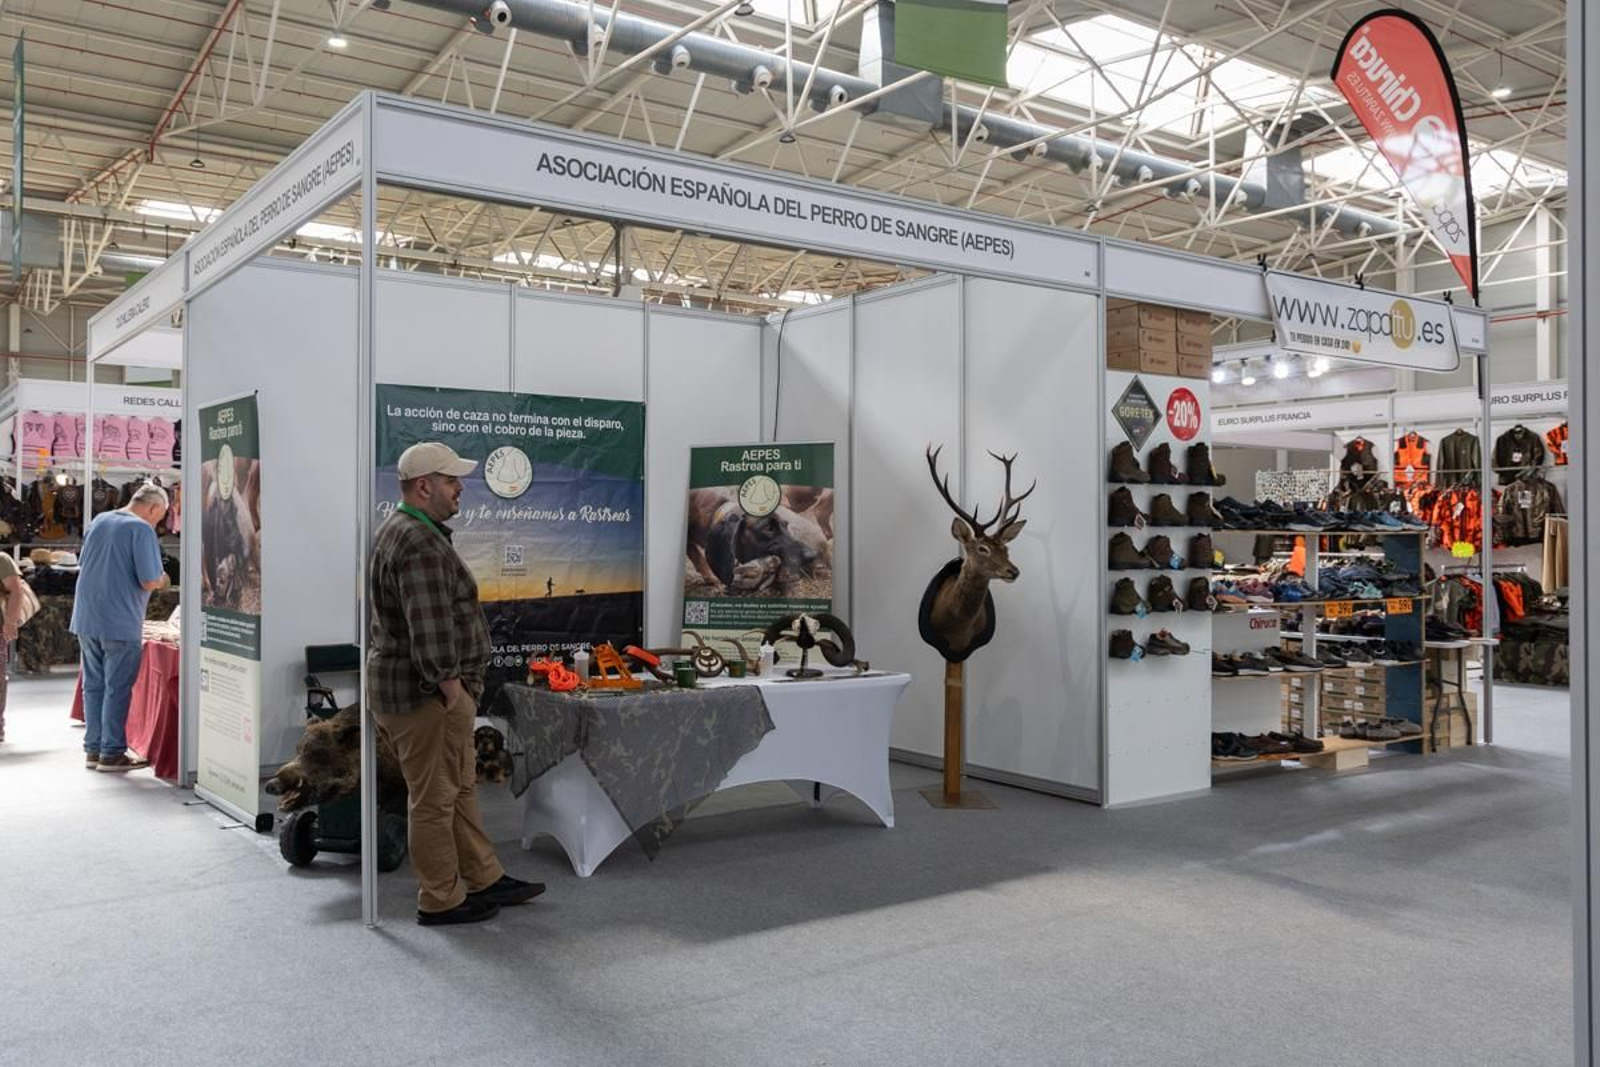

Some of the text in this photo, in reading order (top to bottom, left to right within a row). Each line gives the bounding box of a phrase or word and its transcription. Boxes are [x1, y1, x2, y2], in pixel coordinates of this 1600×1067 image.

[292, 165, 321, 204] SANGRE
[323, 139, 354, 186] (AEPES)
[536, 152, 1015, 260] ASOCIACIÓN ESPAÑOLA DEL PERRO DE SANGRE (AEPES)
[123, 395, 155, 406] REDES
[1511, 391, 1562, 404] SURPLUS
[387, 404, 624, 431] La acción de caza no termina con el disparo,
[1168, 399, 1198, 429] -20%
[1217, 411, 1311, 426] EURO SURPLUS FRANCIA
[431, 421, 586, 440] sino con el cobro de la pieza.
[741, 449, 781, 461] AEPES
[720, 459, 802, 474] Rastrea para ti
[465, 509, 476, 527] y
[480, 503, 492, 521] te
[567, 511, 578, 521] a
[578, 505, 631, 523] Rastrear
